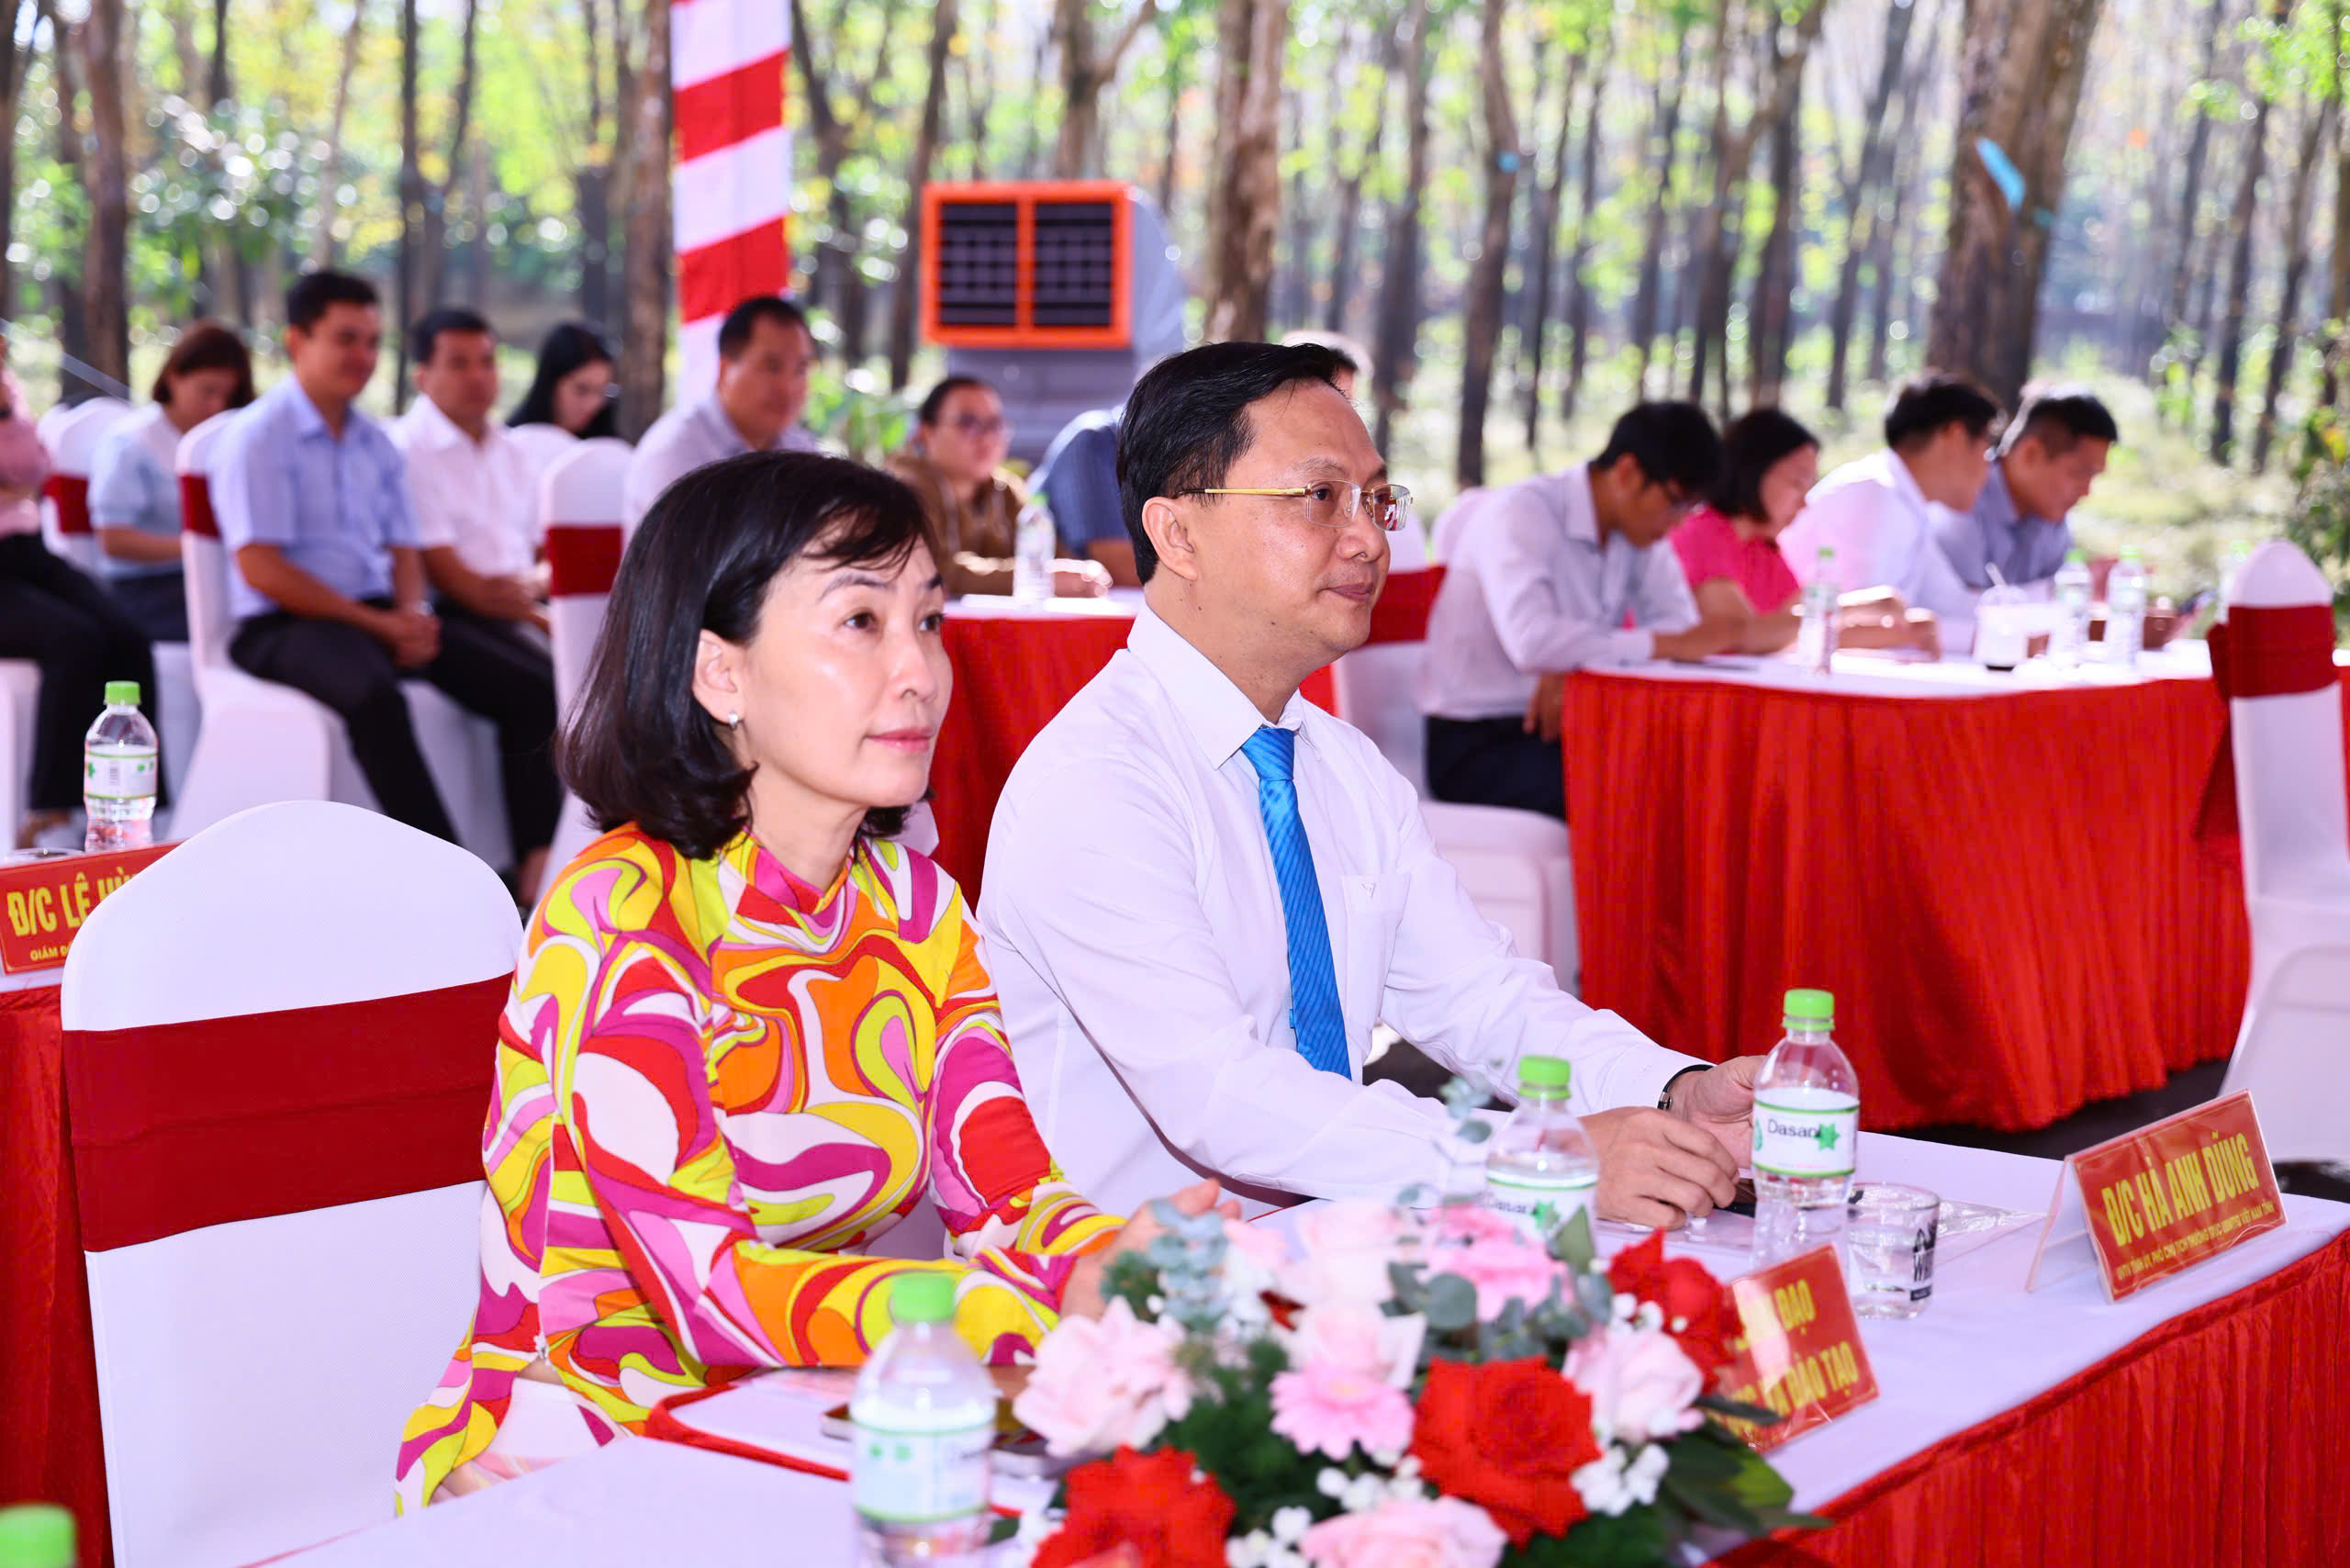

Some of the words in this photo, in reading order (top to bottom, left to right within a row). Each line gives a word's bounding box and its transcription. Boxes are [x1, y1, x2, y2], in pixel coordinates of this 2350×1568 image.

[6, 887, 57, 936] Đ/C
[60, 871, 91, 929] LÊ
[2100, 1179, 2144, 1247] Đ/C
[2135, 1155, 2175, 1232] HÀ
[2165, 1151, 2213, 1220] ANH
[1819, 1340, 1859, 1396] TẠO
